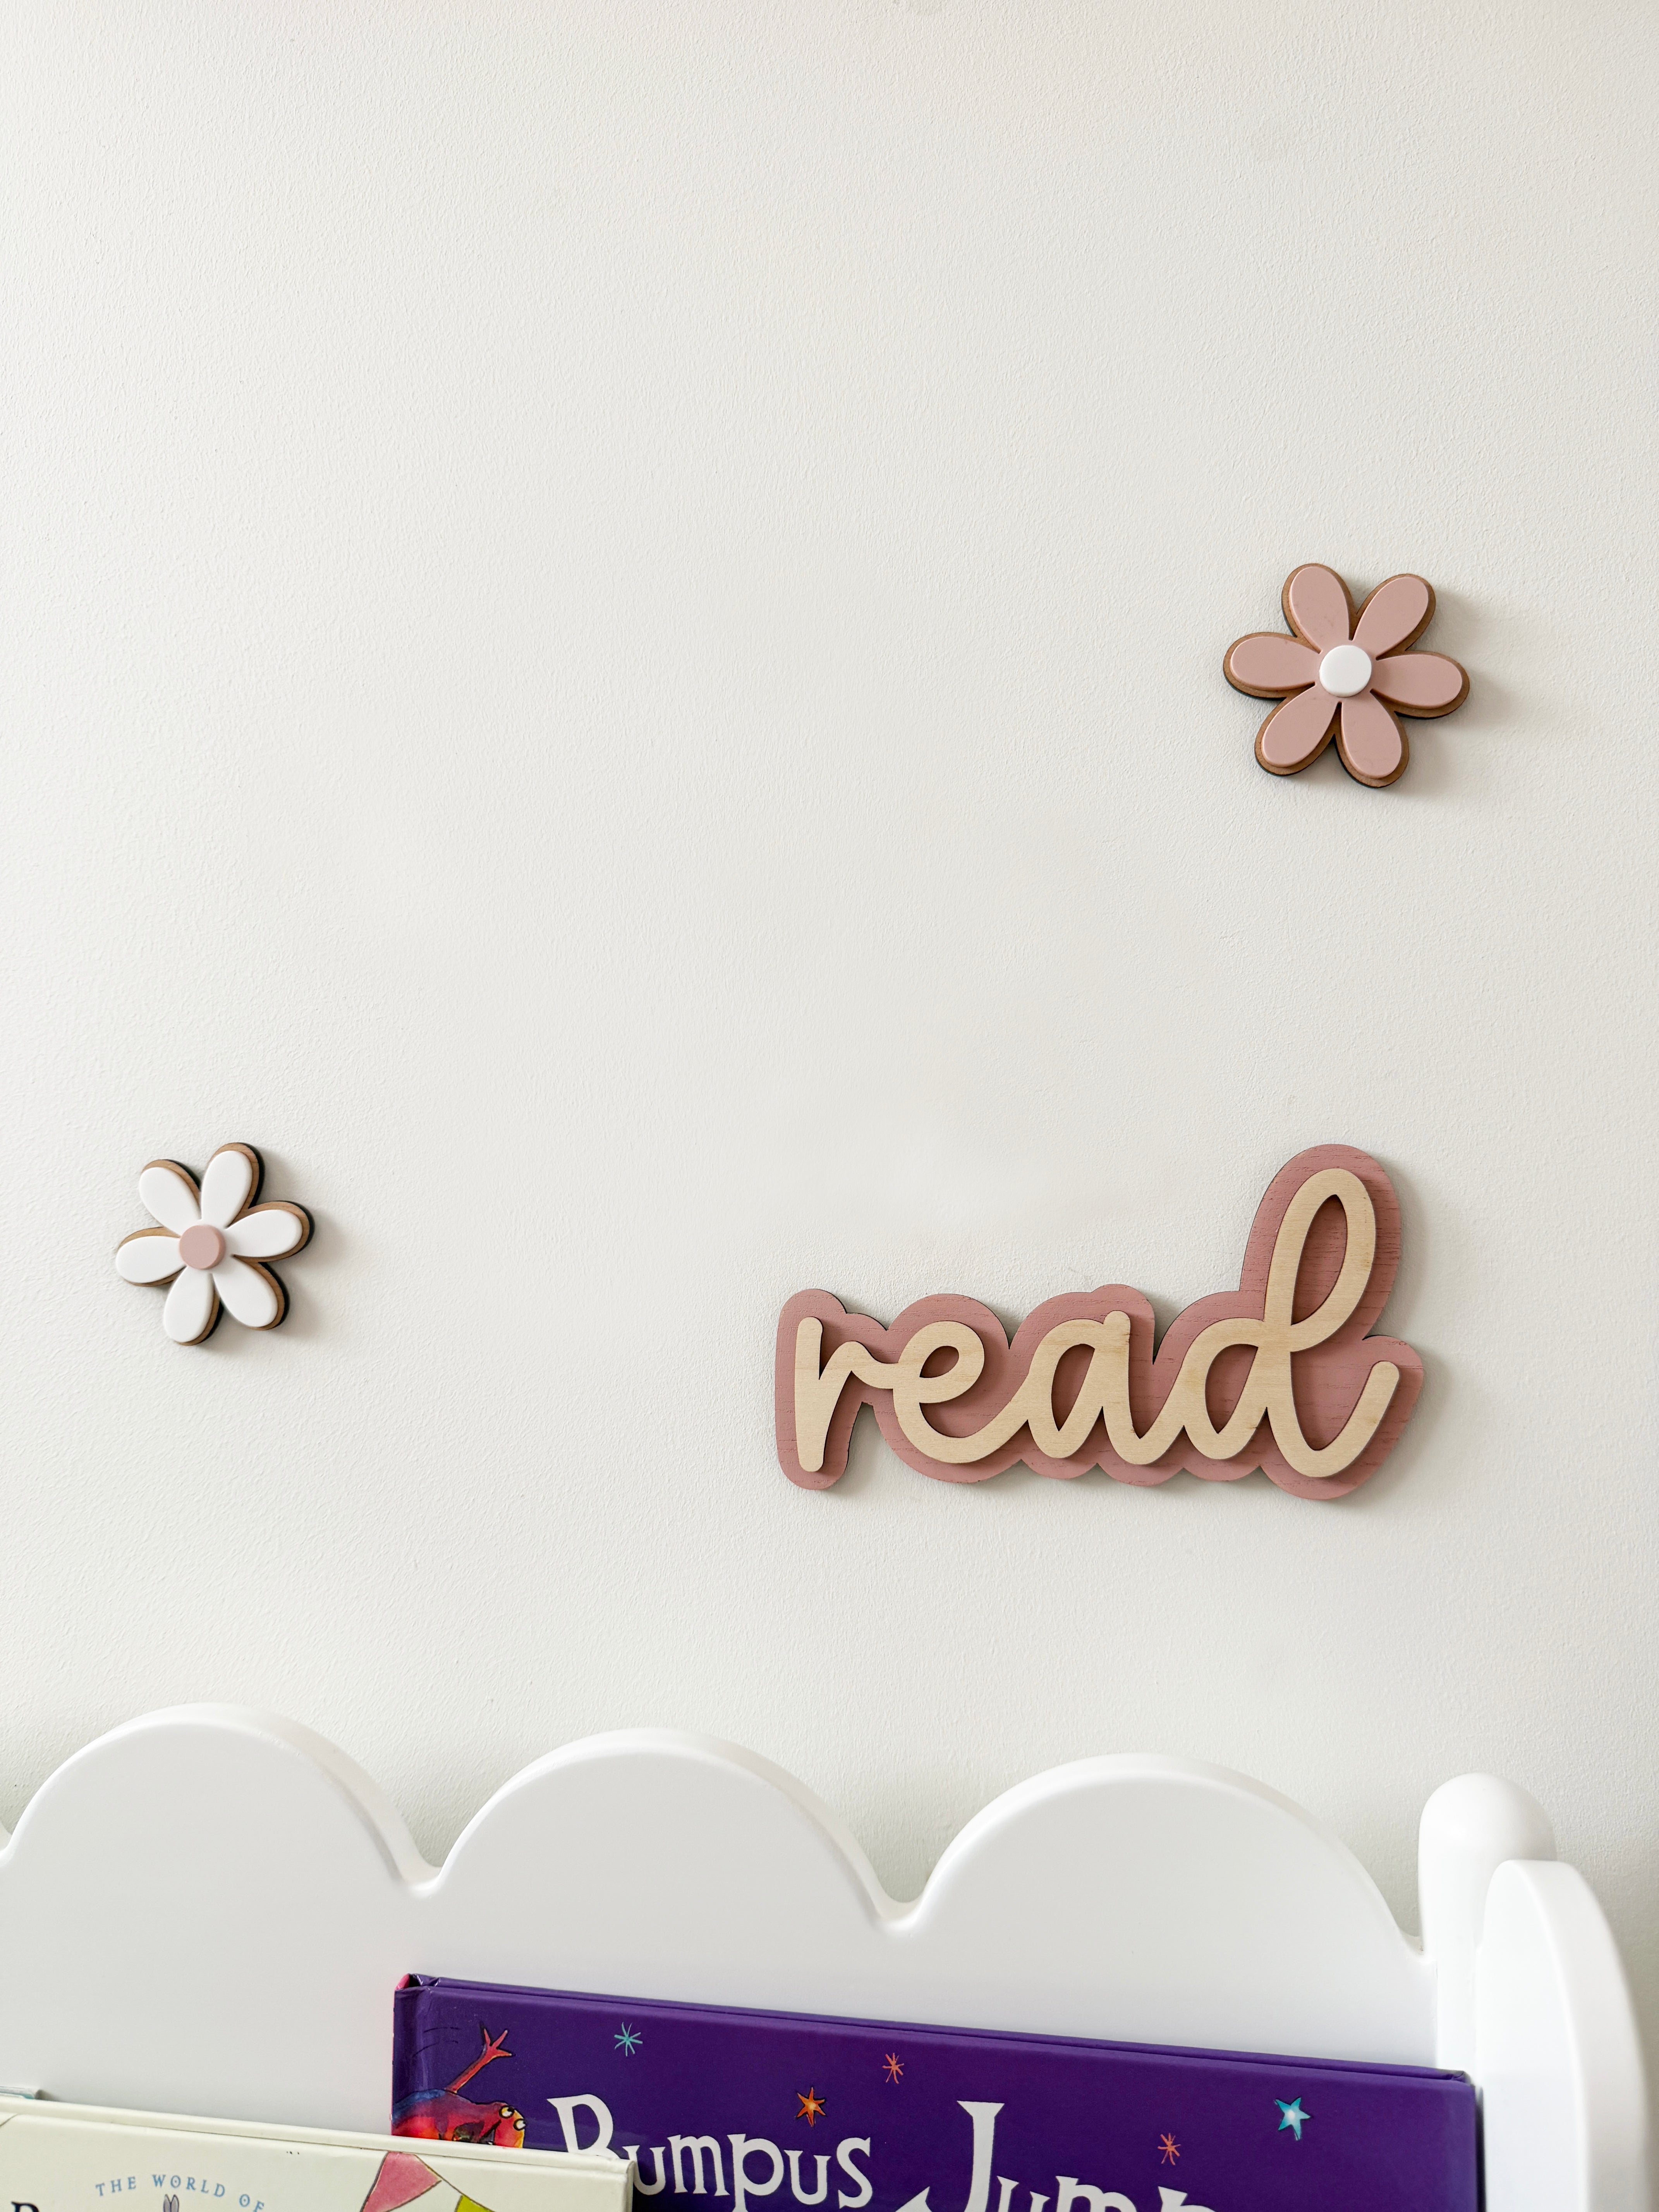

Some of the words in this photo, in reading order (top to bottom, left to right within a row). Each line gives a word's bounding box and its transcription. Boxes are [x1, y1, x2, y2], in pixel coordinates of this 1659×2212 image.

[794, 1167, 1400, 1479] read
[95, 2176, 136, 2197] THE
[152, 2174, 225, 2198] WORLD
[239, 2194, 264, 2212] OF
